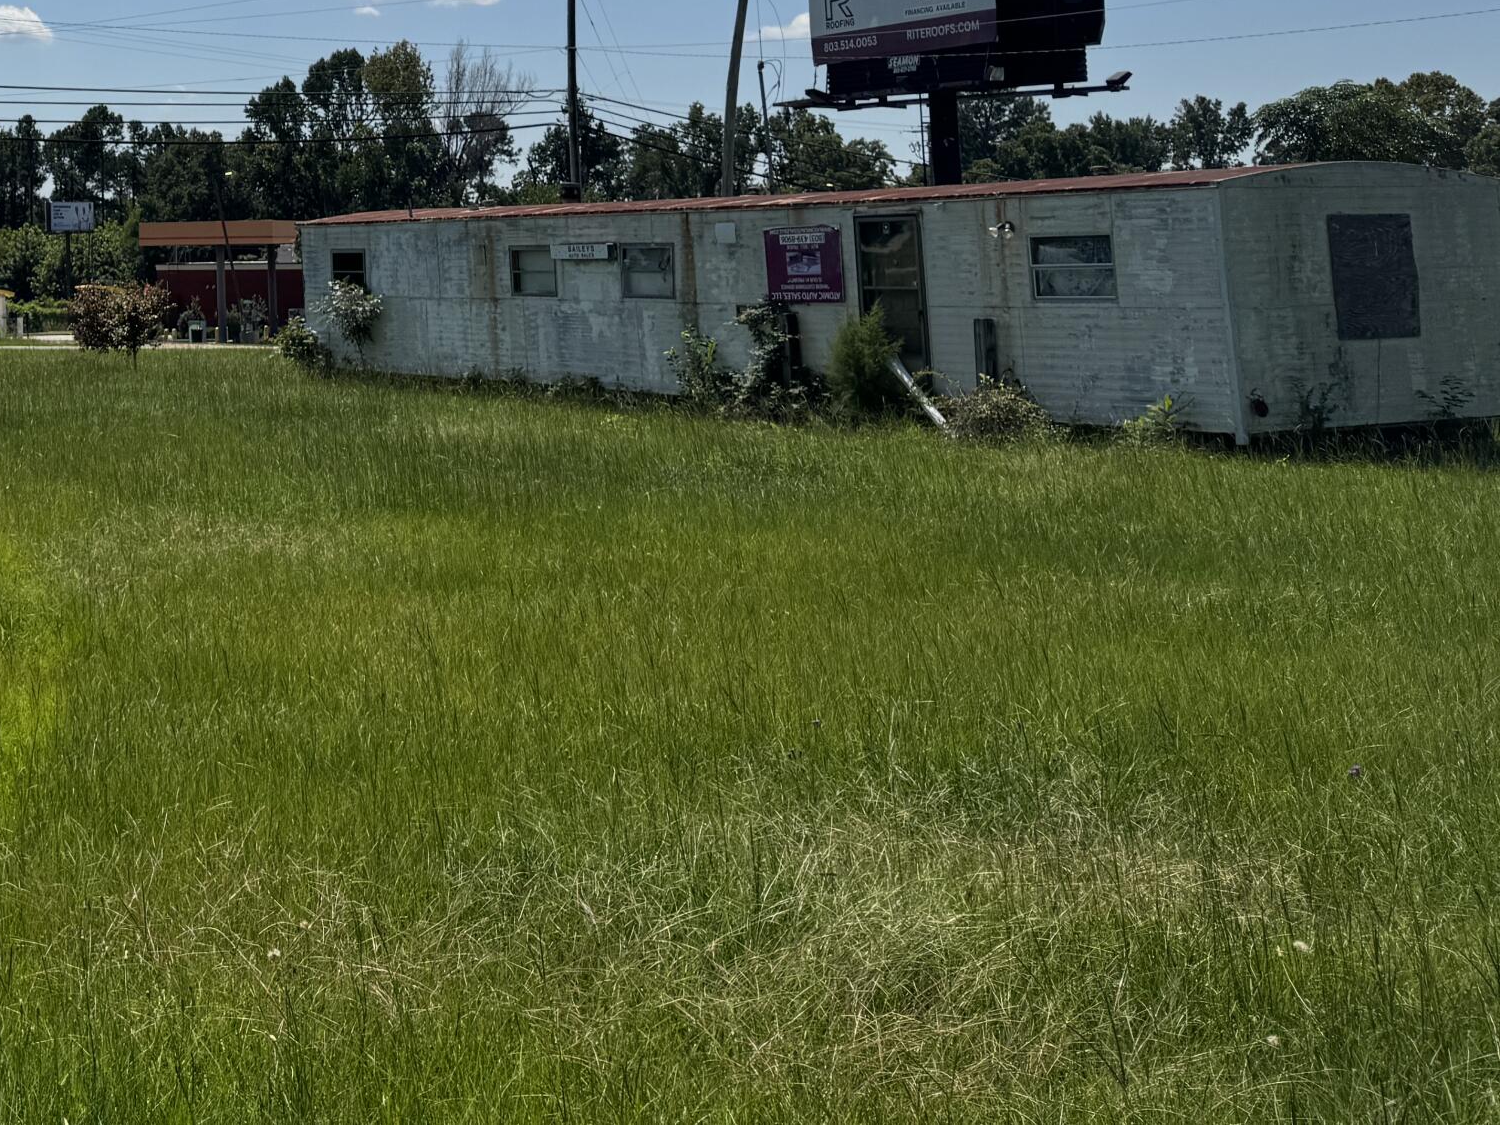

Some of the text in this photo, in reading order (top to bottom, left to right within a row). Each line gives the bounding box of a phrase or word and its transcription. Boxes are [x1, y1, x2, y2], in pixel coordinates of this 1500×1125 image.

[905, 1, 966, 16] FINANCING AVAILABLE
[826, 17, 855, 30] ROOFING
[906, 19, 980, 41] RITEROOFS.COM
[823, 35, 878, 53] 803.514.0053
[888, 54, 919, 67] SEAMON
